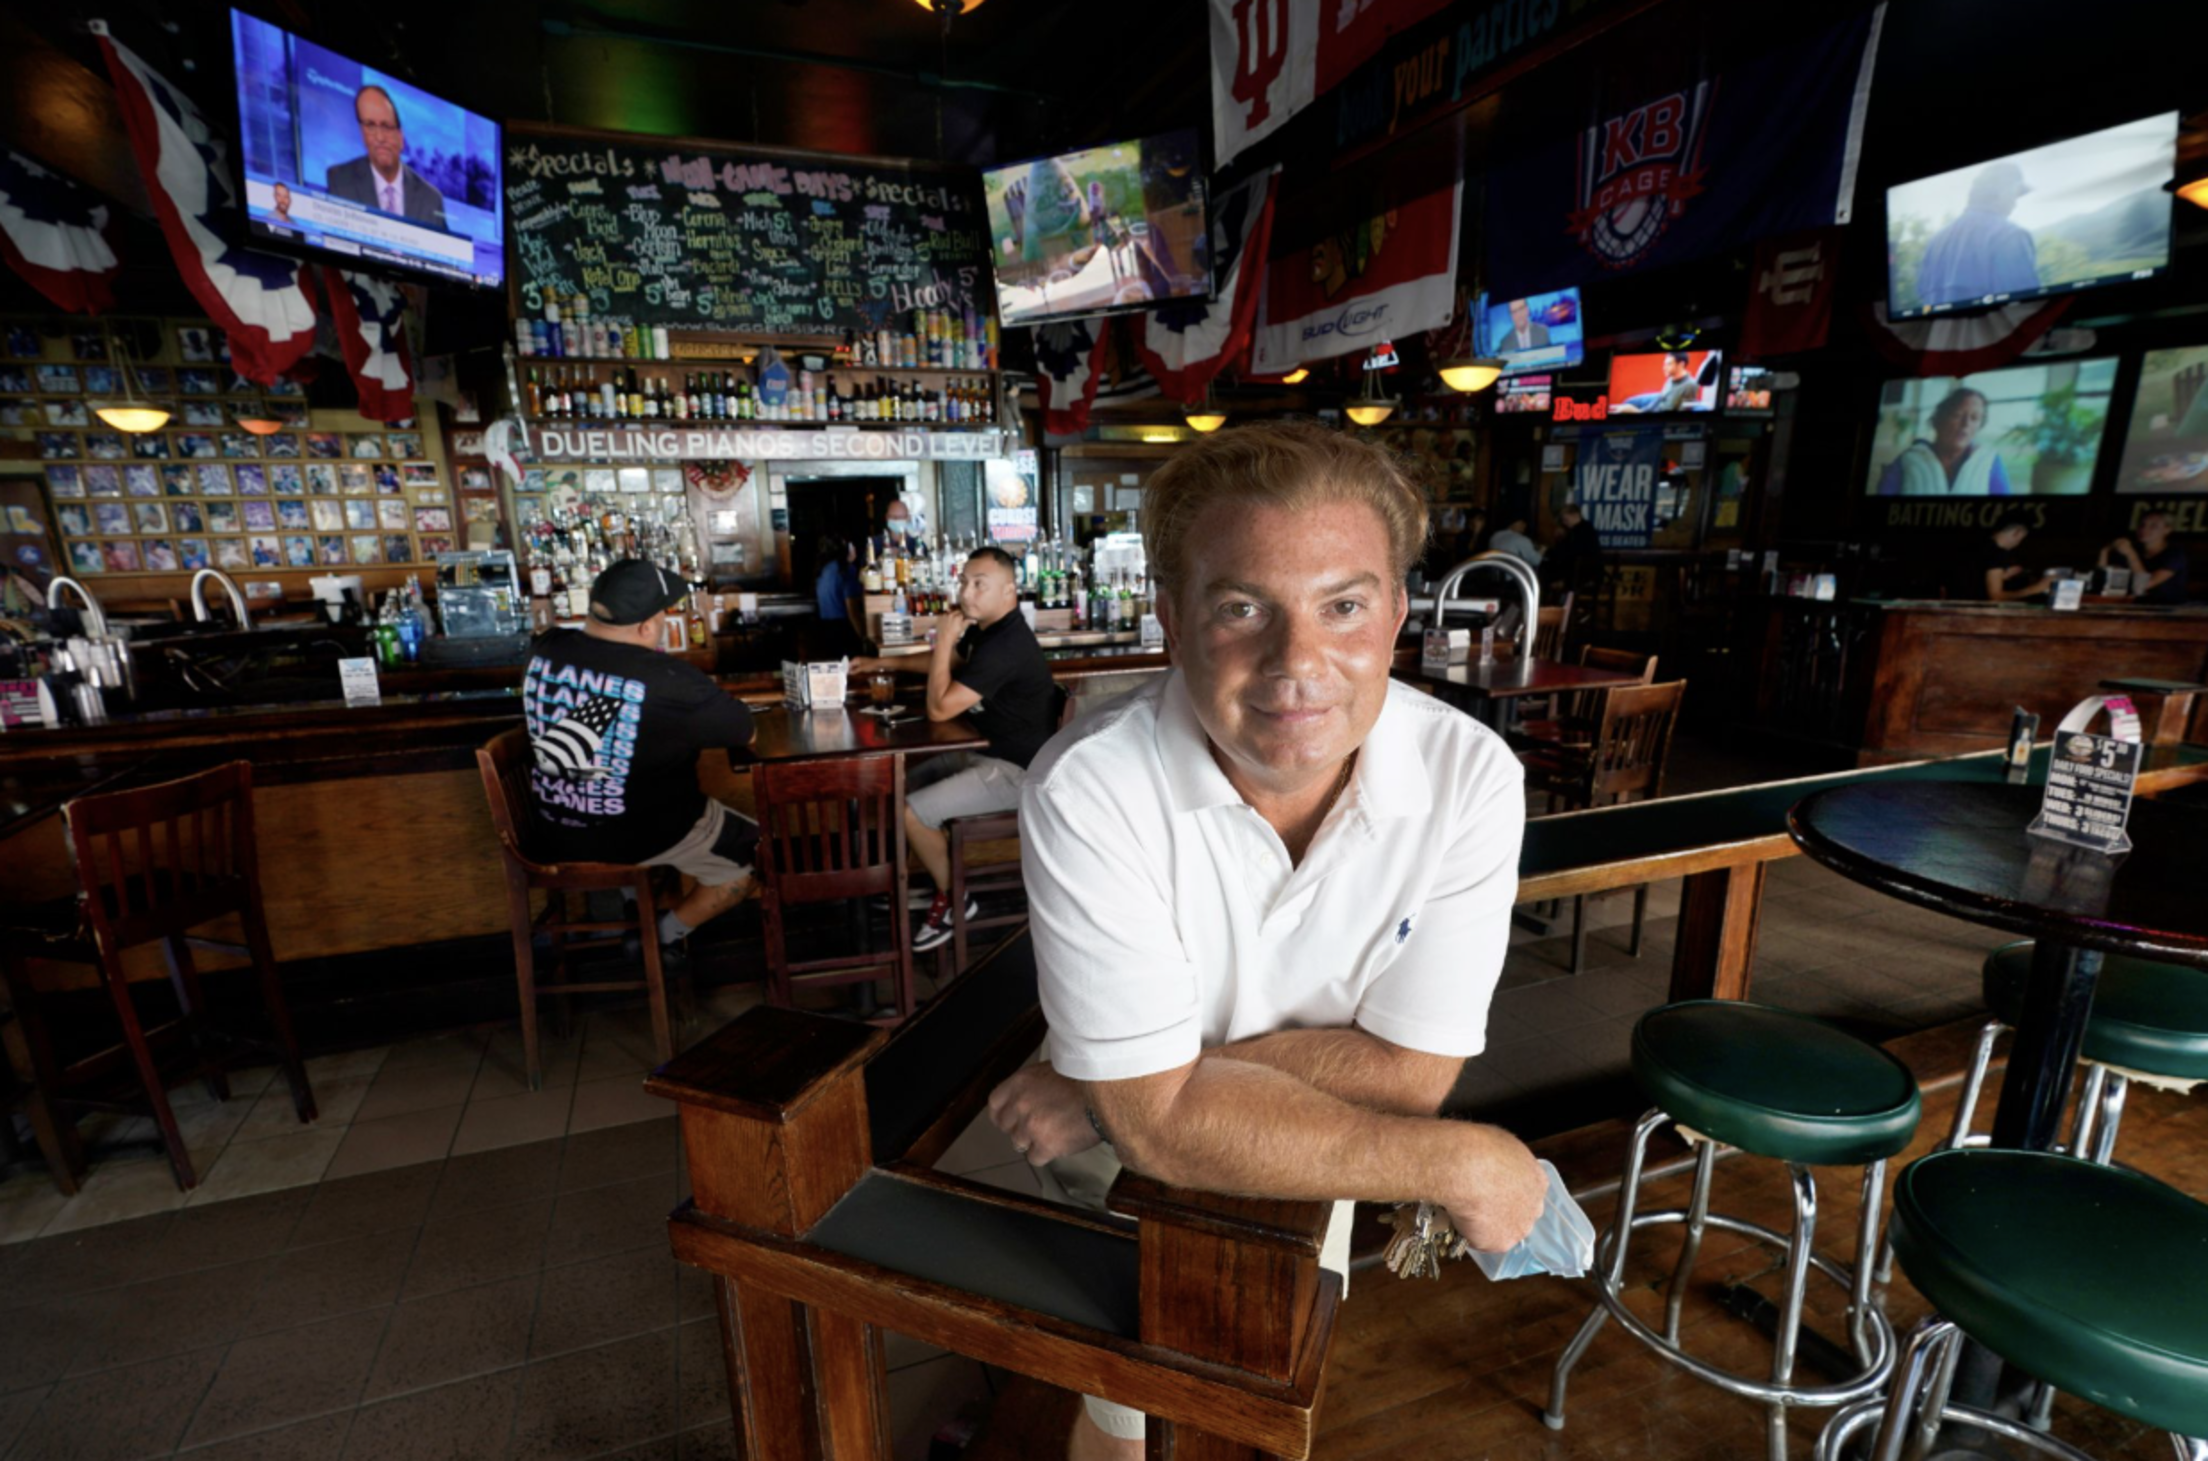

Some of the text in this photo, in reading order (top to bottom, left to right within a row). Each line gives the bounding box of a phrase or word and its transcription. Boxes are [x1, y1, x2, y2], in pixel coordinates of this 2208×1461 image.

[1388, 36, 1450, 135] your
[1452, 0, 1558, 102] parties
[1600, 92, 1685, 183] KB
[794, 172, 853, 202] DAYS
[1600, 168, 1671, 207] CAGE
[1303, 303, 1389, 341] BUD LIGHT
[1552, 395, 1607, 422] Bud
[542, 431, 677, 458] DUELING
[686, 433, 793, 457] PIANOS
[811, 434, 923, 458] SECOND
[1583, 465, 1652, 501] WEAR
[1594, 504, 1648, 531] MASK
[1888, 502, 1971, 526] BATTING
[527, 655, 645, 704] PLANES
